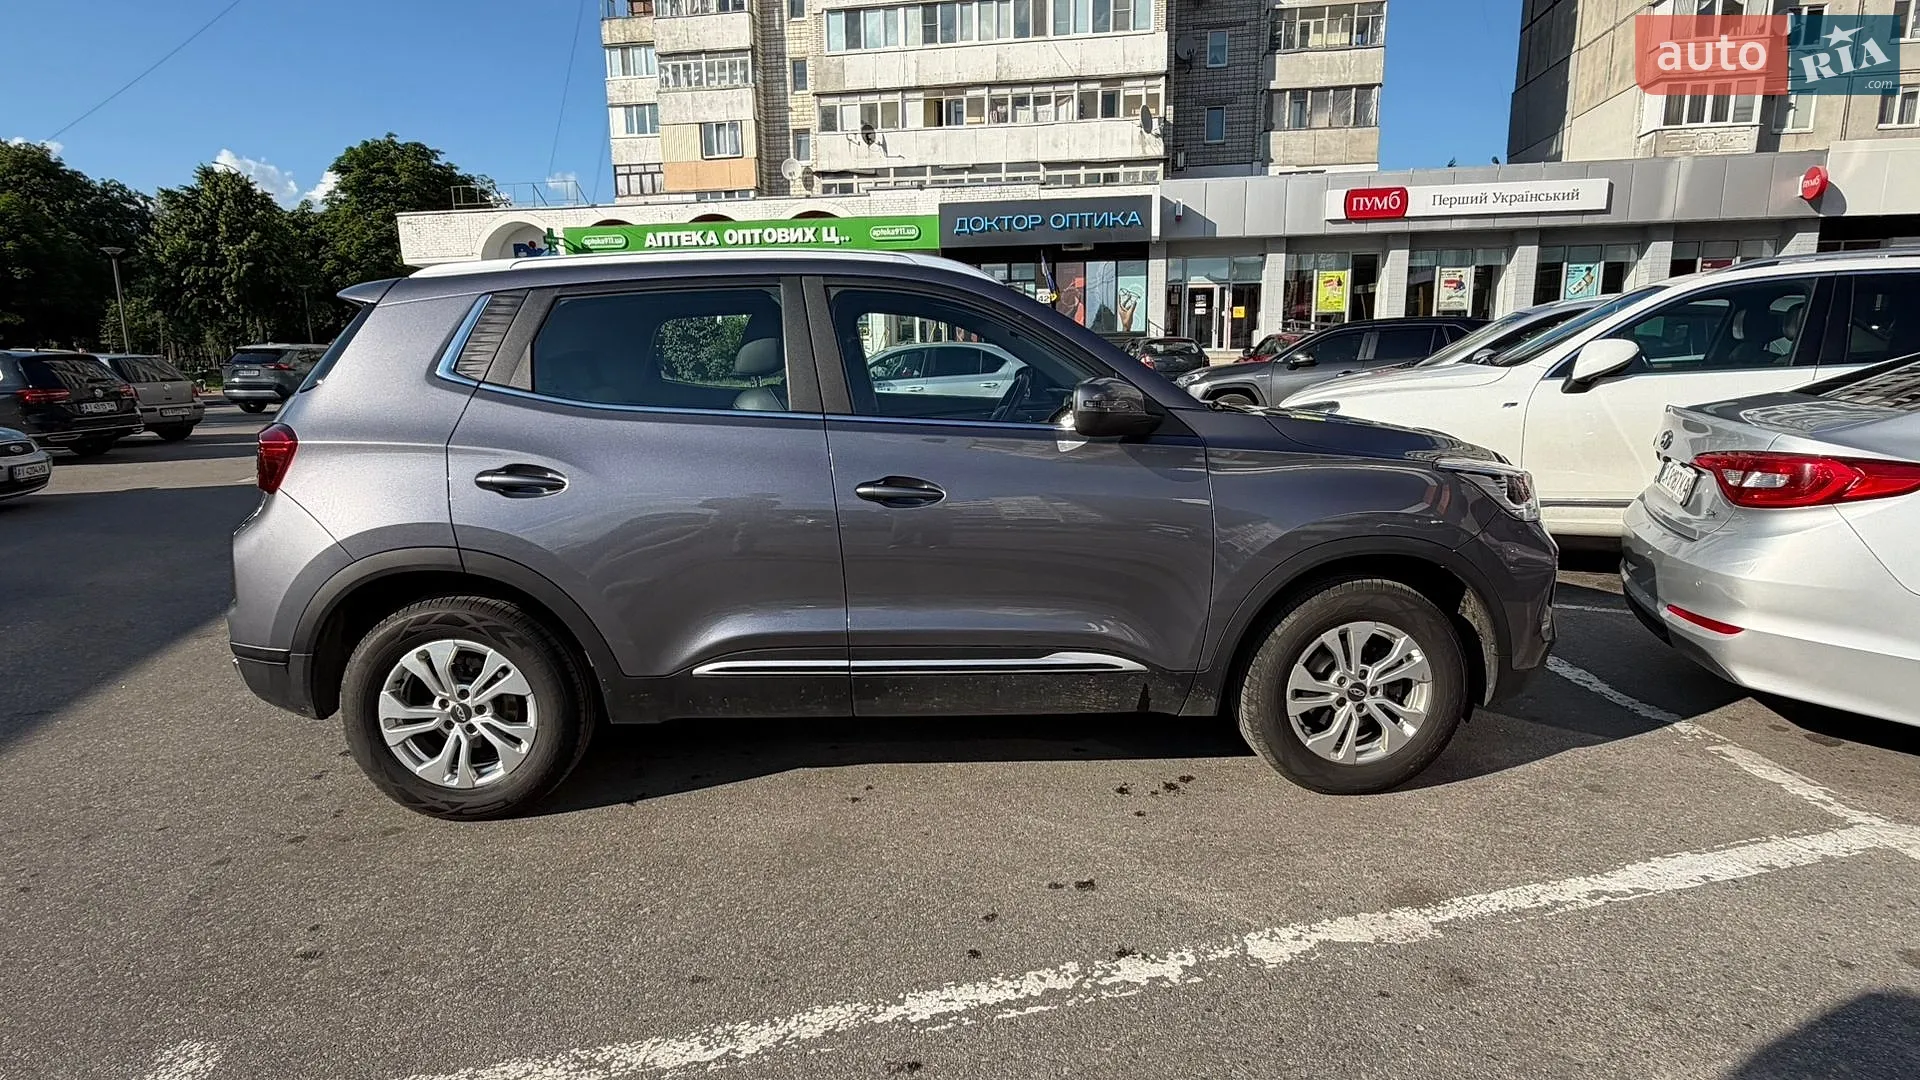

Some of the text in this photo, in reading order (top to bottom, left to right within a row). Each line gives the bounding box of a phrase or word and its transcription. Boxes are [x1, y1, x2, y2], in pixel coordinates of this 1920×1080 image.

[1432, 192, 1489, 207] Перший
[1492, 187, 1581, 205] Український
[954, 211, 1143, 235] ДОКТОР ОПТИКА
[644, 230, 719, 247] АПТЕКА
[724, 226, 818, 244] ОПТОВИХ
